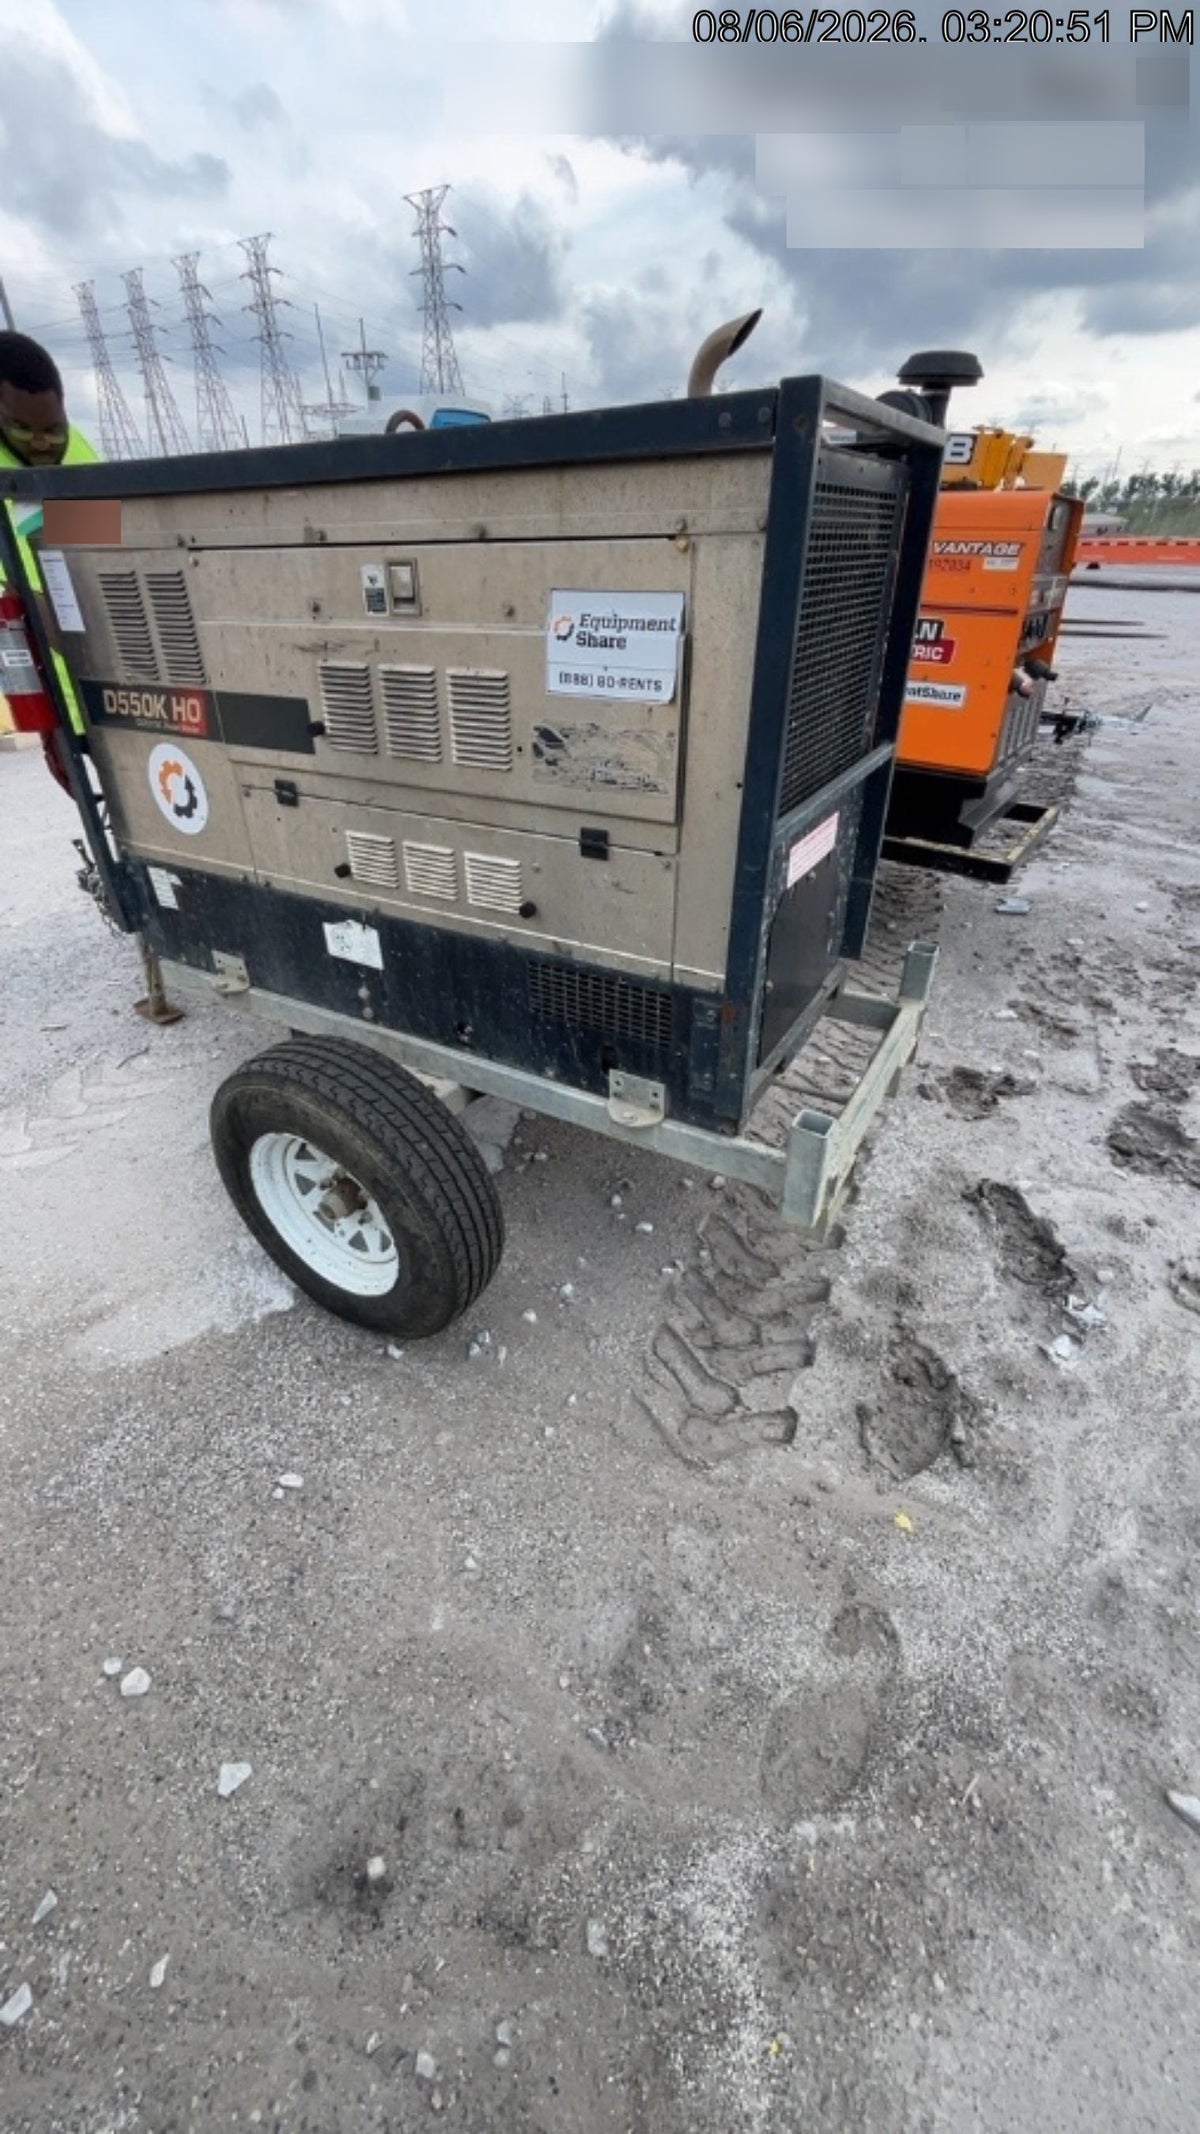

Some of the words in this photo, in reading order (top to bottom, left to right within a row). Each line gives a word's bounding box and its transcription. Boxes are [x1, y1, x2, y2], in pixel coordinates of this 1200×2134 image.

[933, 541, 1022, 556] VANTAGE
[579, 612, 677, 633] Equipment
[575, 630, 627, 650] Share
[912, 644, 944, 661] RIC
[102, 689, 168, 720] D550K
[171, 696, 201, 724] HO
